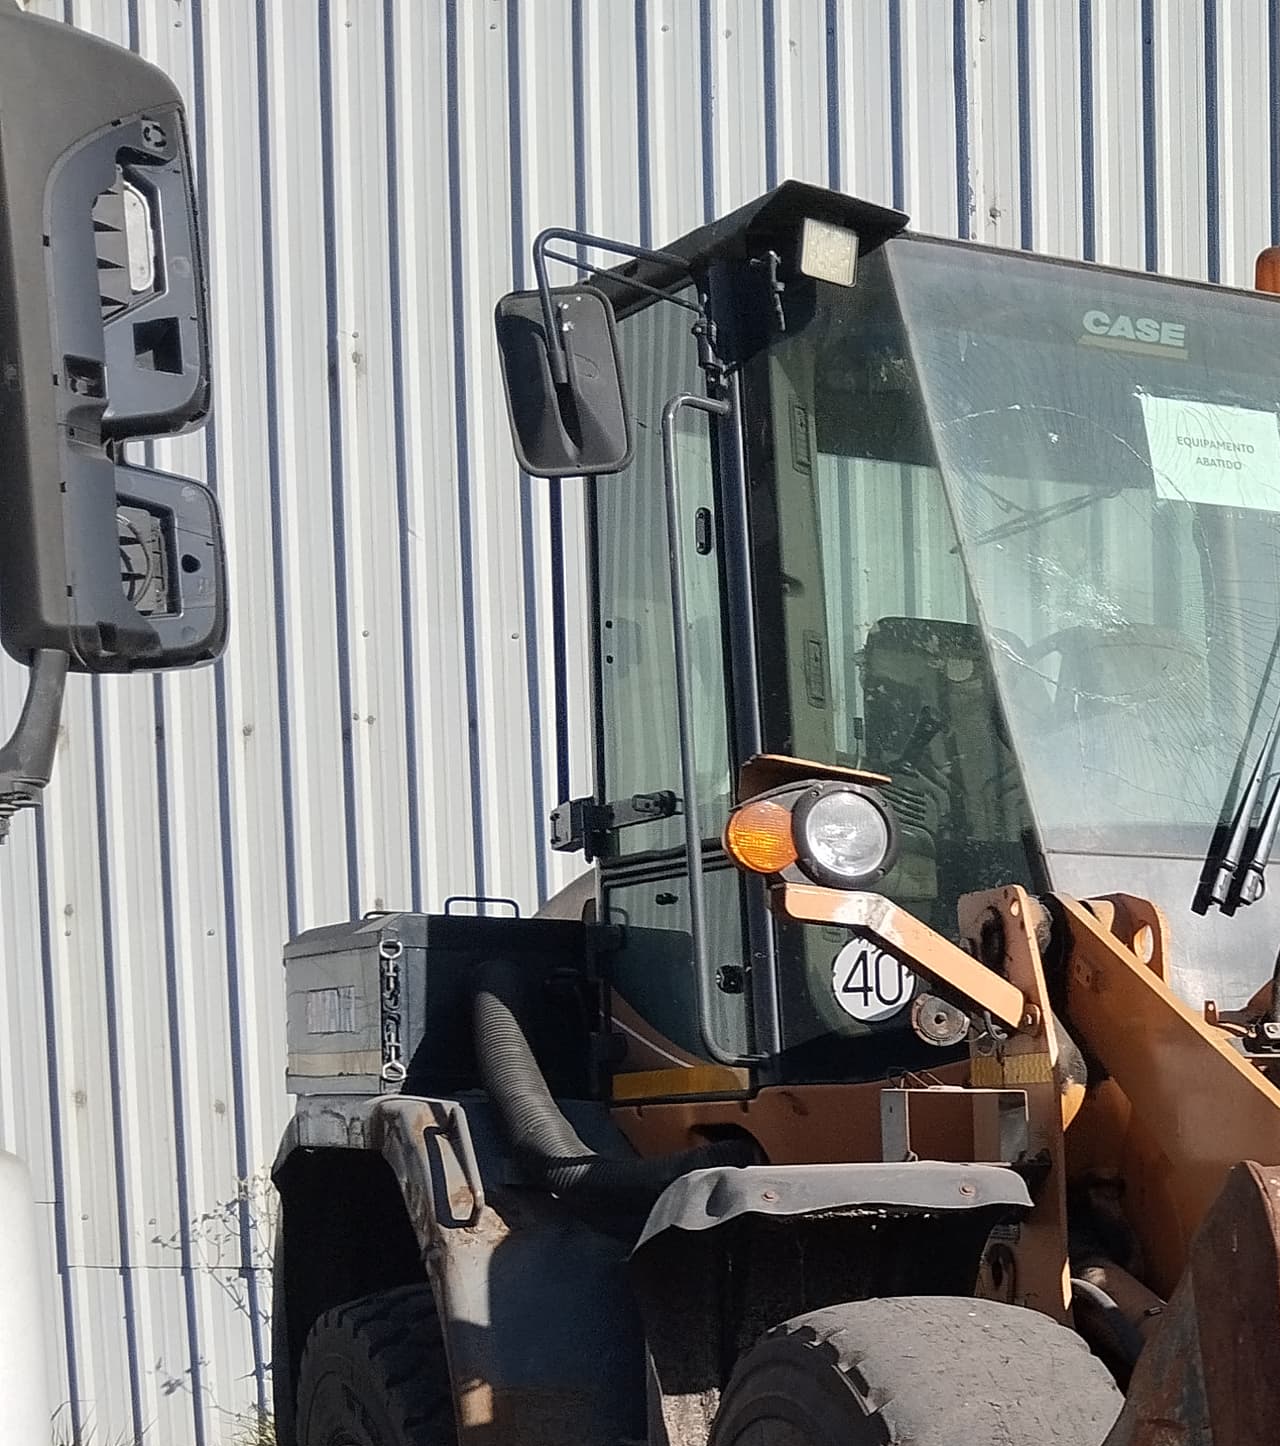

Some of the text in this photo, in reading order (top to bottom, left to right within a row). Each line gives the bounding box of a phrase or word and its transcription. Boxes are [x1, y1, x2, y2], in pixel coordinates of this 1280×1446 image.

[1082, 309, 1185, 347] CASE
[1176, 435, 1254, 455] EQUIPAMENTO
[1195, 455, 1243, 471] ABATIDO
[841, 949, 904, 1006] 40
